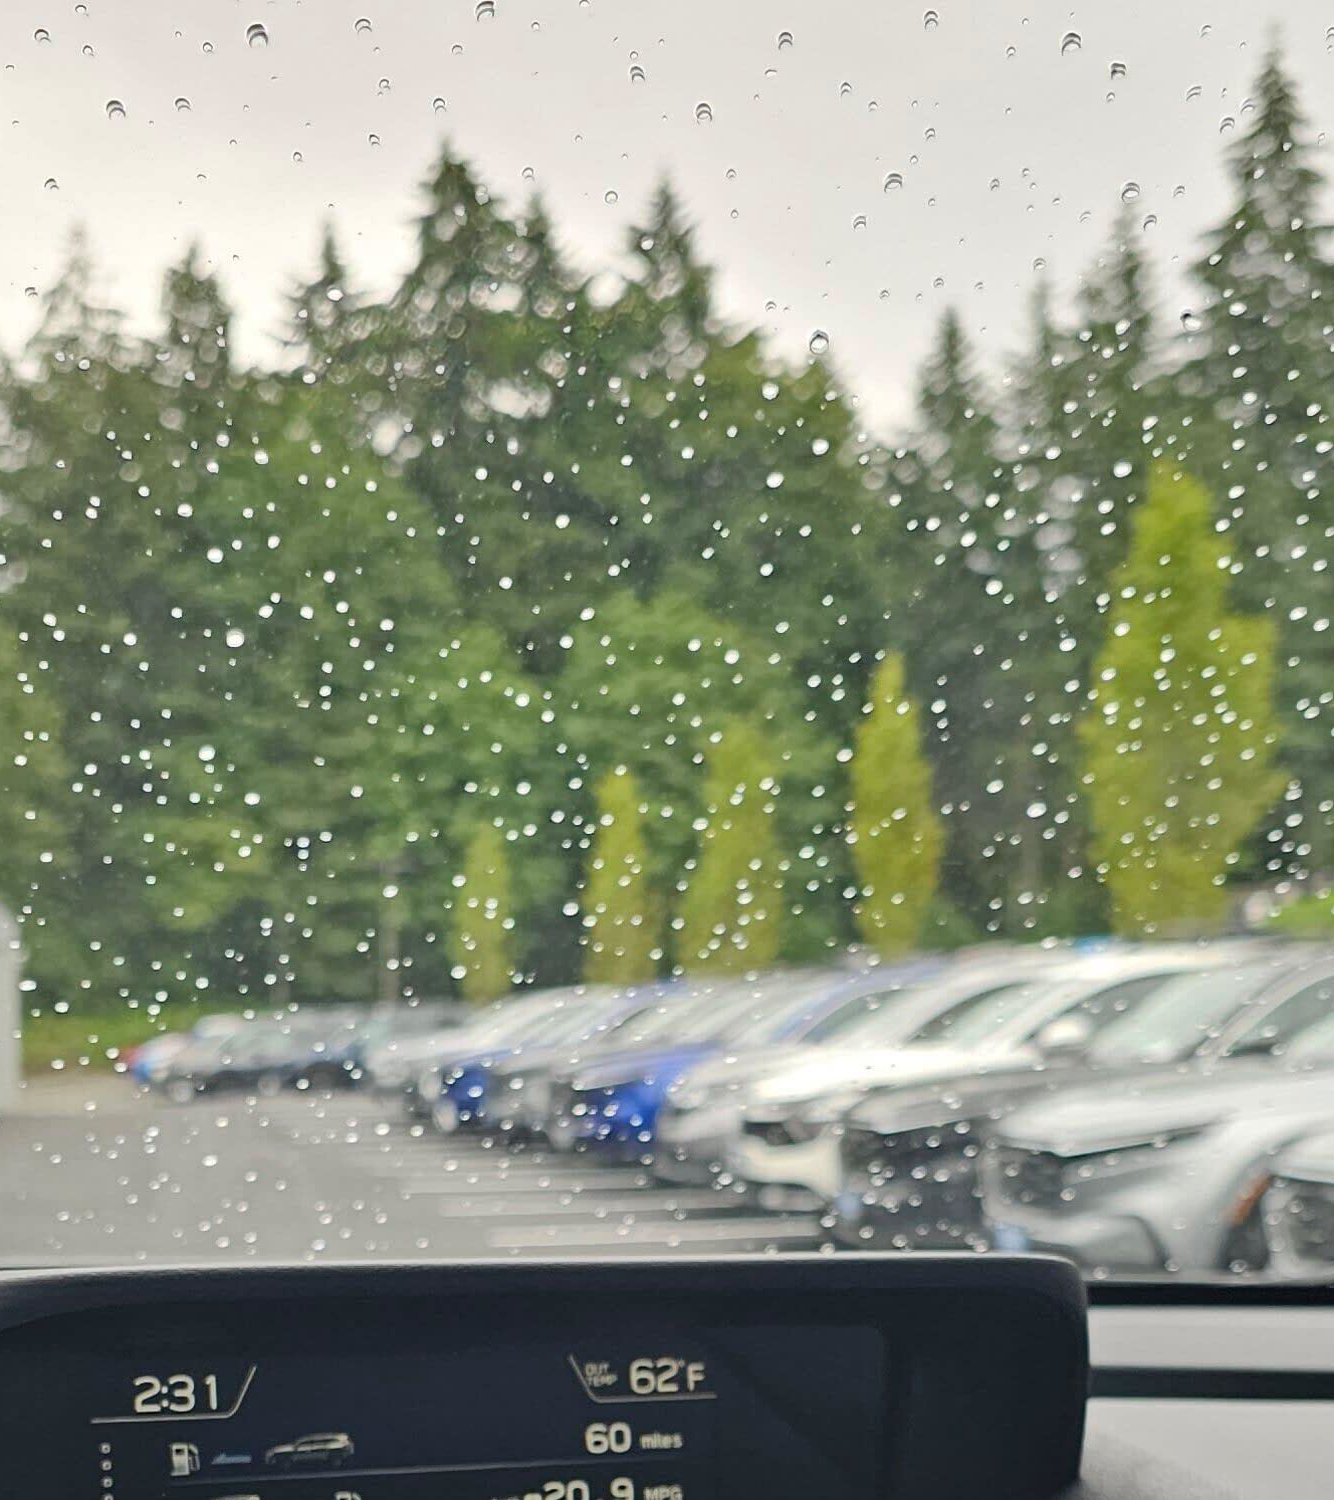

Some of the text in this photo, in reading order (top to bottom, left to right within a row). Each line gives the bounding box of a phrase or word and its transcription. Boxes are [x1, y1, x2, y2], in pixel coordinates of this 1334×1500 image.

[134, 1374, 218, 1413] 2:31
[585, 1422, 683, 1454] 60 miles
